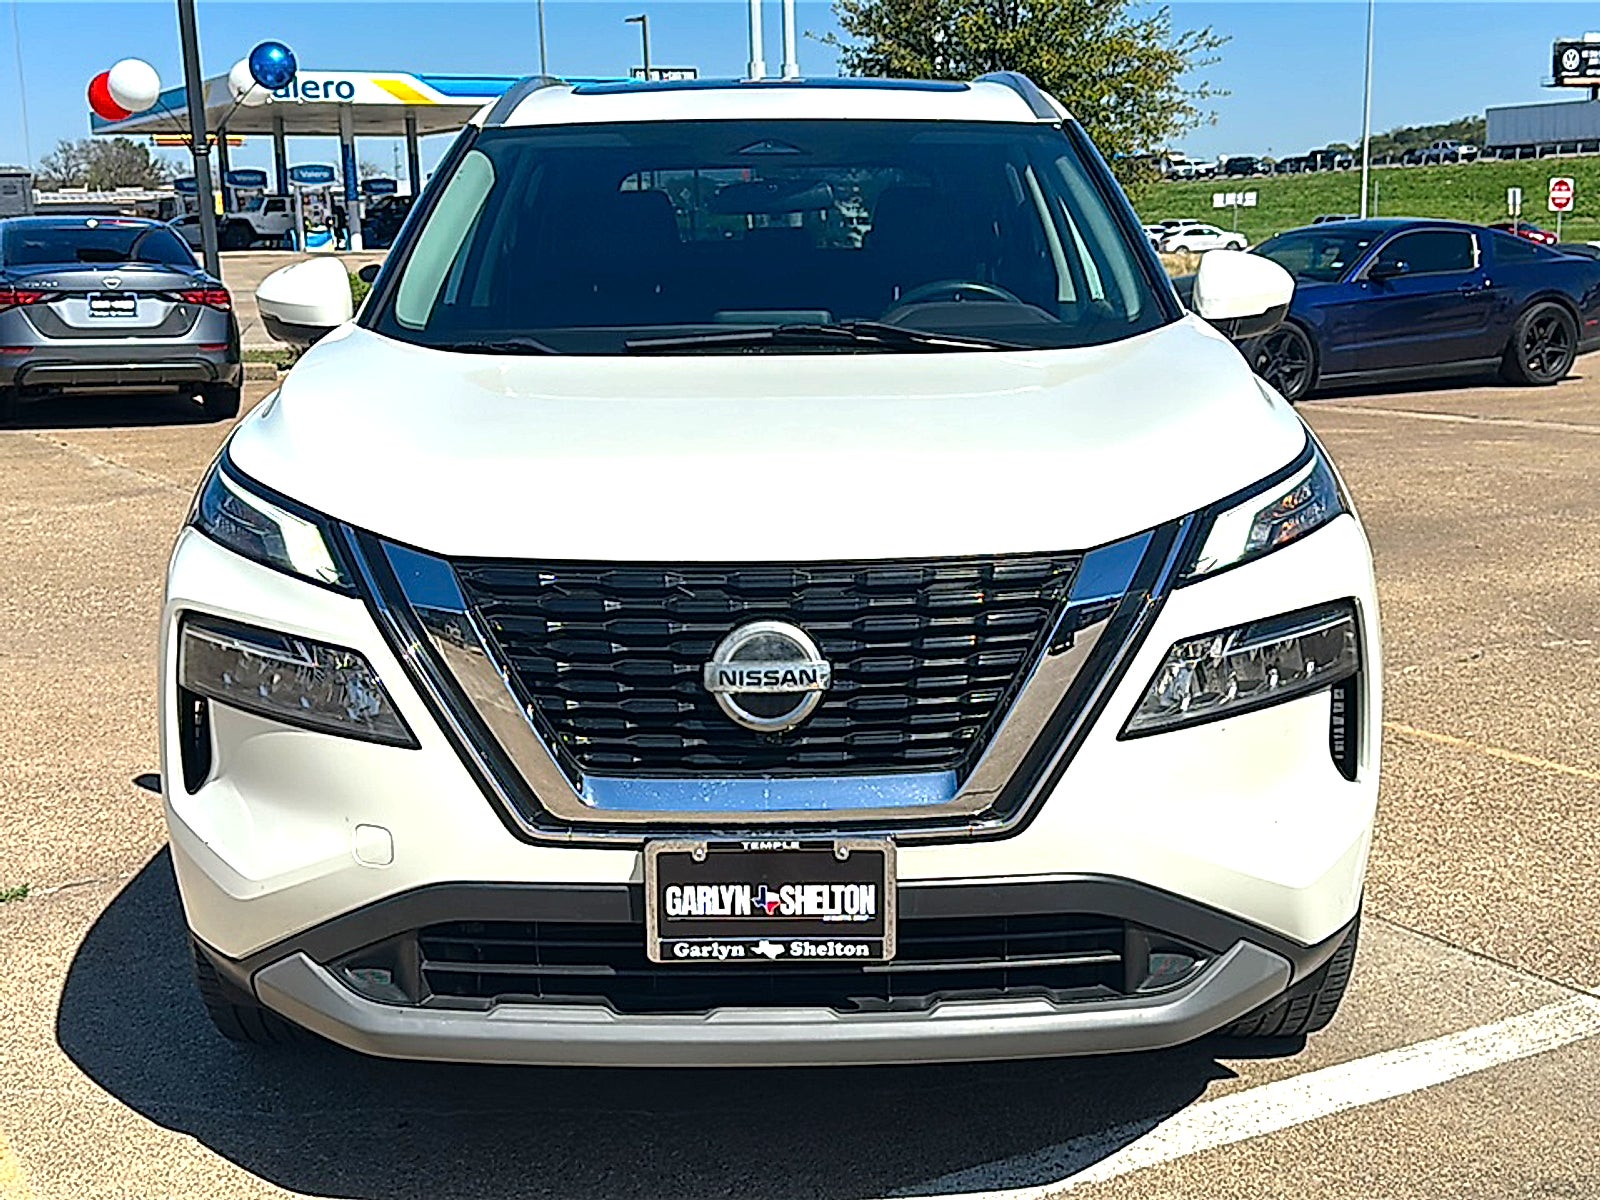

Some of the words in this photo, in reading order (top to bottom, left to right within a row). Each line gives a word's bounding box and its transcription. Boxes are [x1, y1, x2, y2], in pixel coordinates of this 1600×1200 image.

[719, 669, 817, 686] NISSAN
[741, 841, 800, 850] TEMPLE
[666, 885, 751, 916] GARLYN
[780, 884, 876, 915] SHELTON
[673, 943, 745, 960] Garlyn
[790, 942, 870, 957] Shelton
